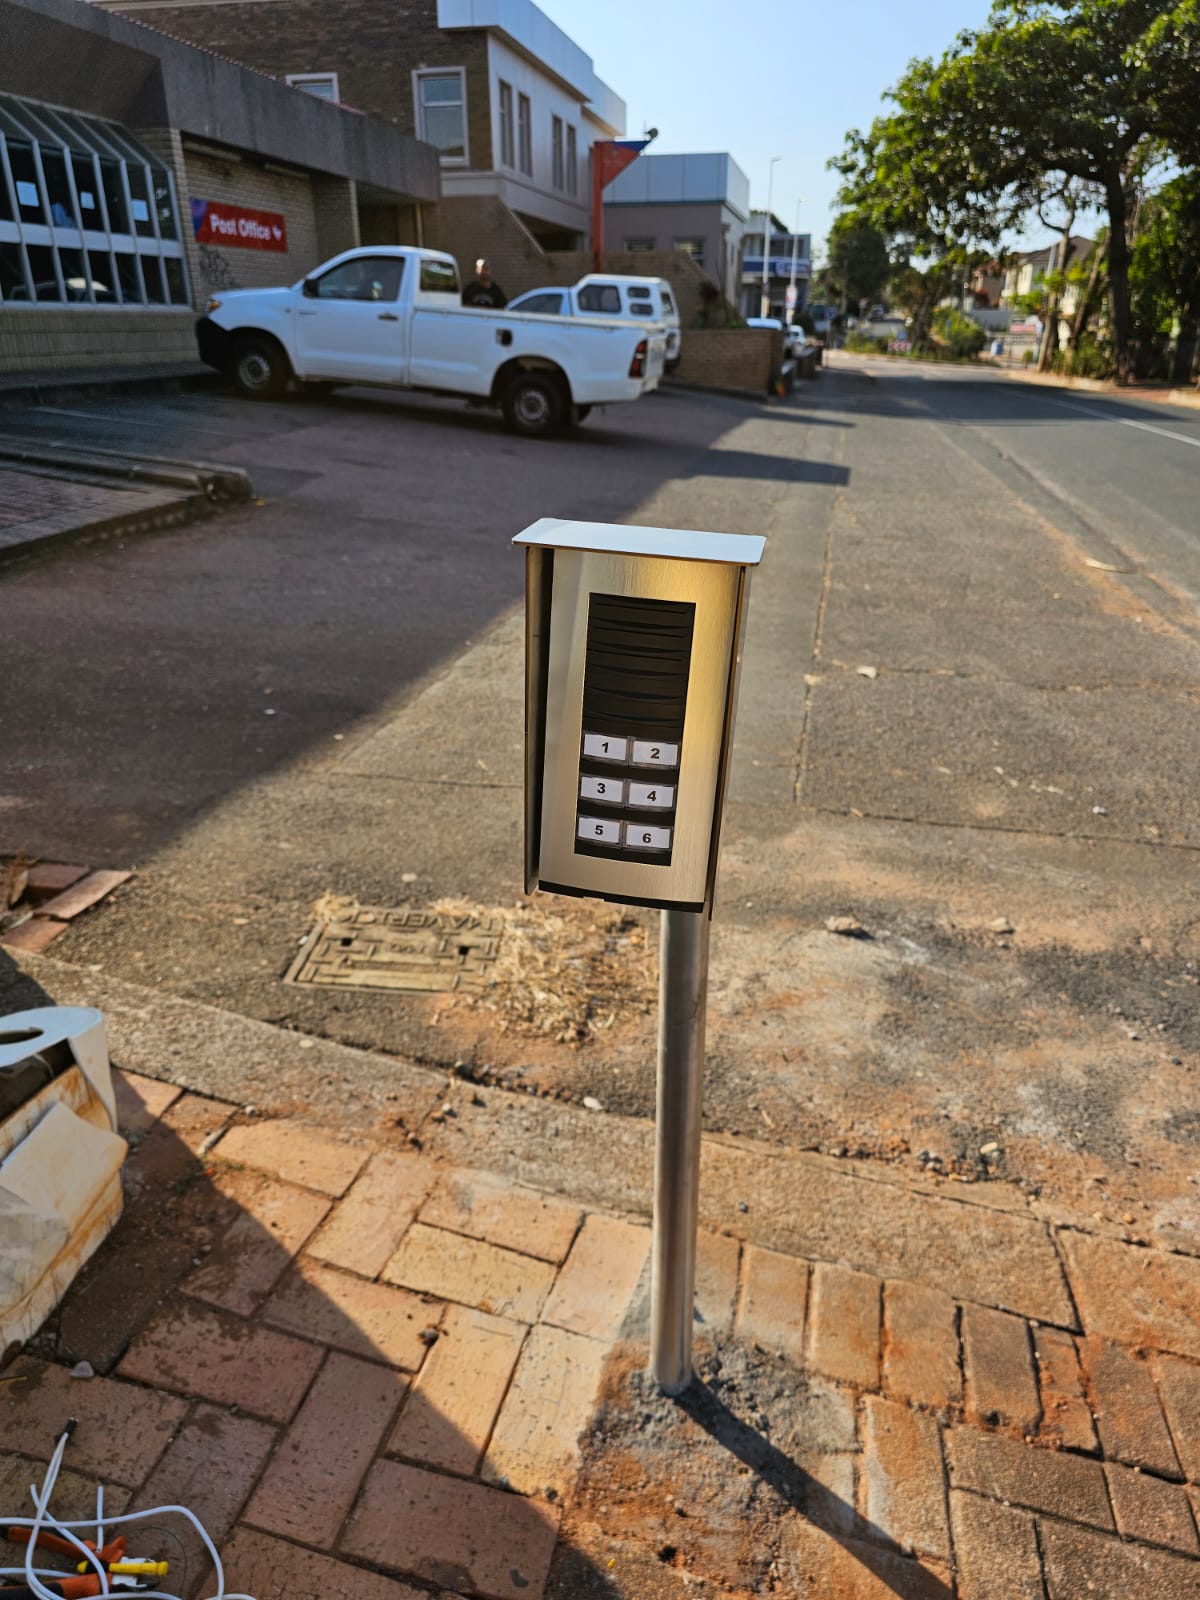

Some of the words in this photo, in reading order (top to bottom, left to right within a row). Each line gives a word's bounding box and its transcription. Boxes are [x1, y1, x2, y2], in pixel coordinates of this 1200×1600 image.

[210, 213, 237, 236] Post
[238, 218, 271, 240] Office
[602, 742, 609, 753] 1
[650, 747, 660, 759] 2
[597, 782, 606, 794] 3
[646, 790, 657, 802] 4
[595, 824, 604, 835] 5
[642, 833, 652, 844] 6
